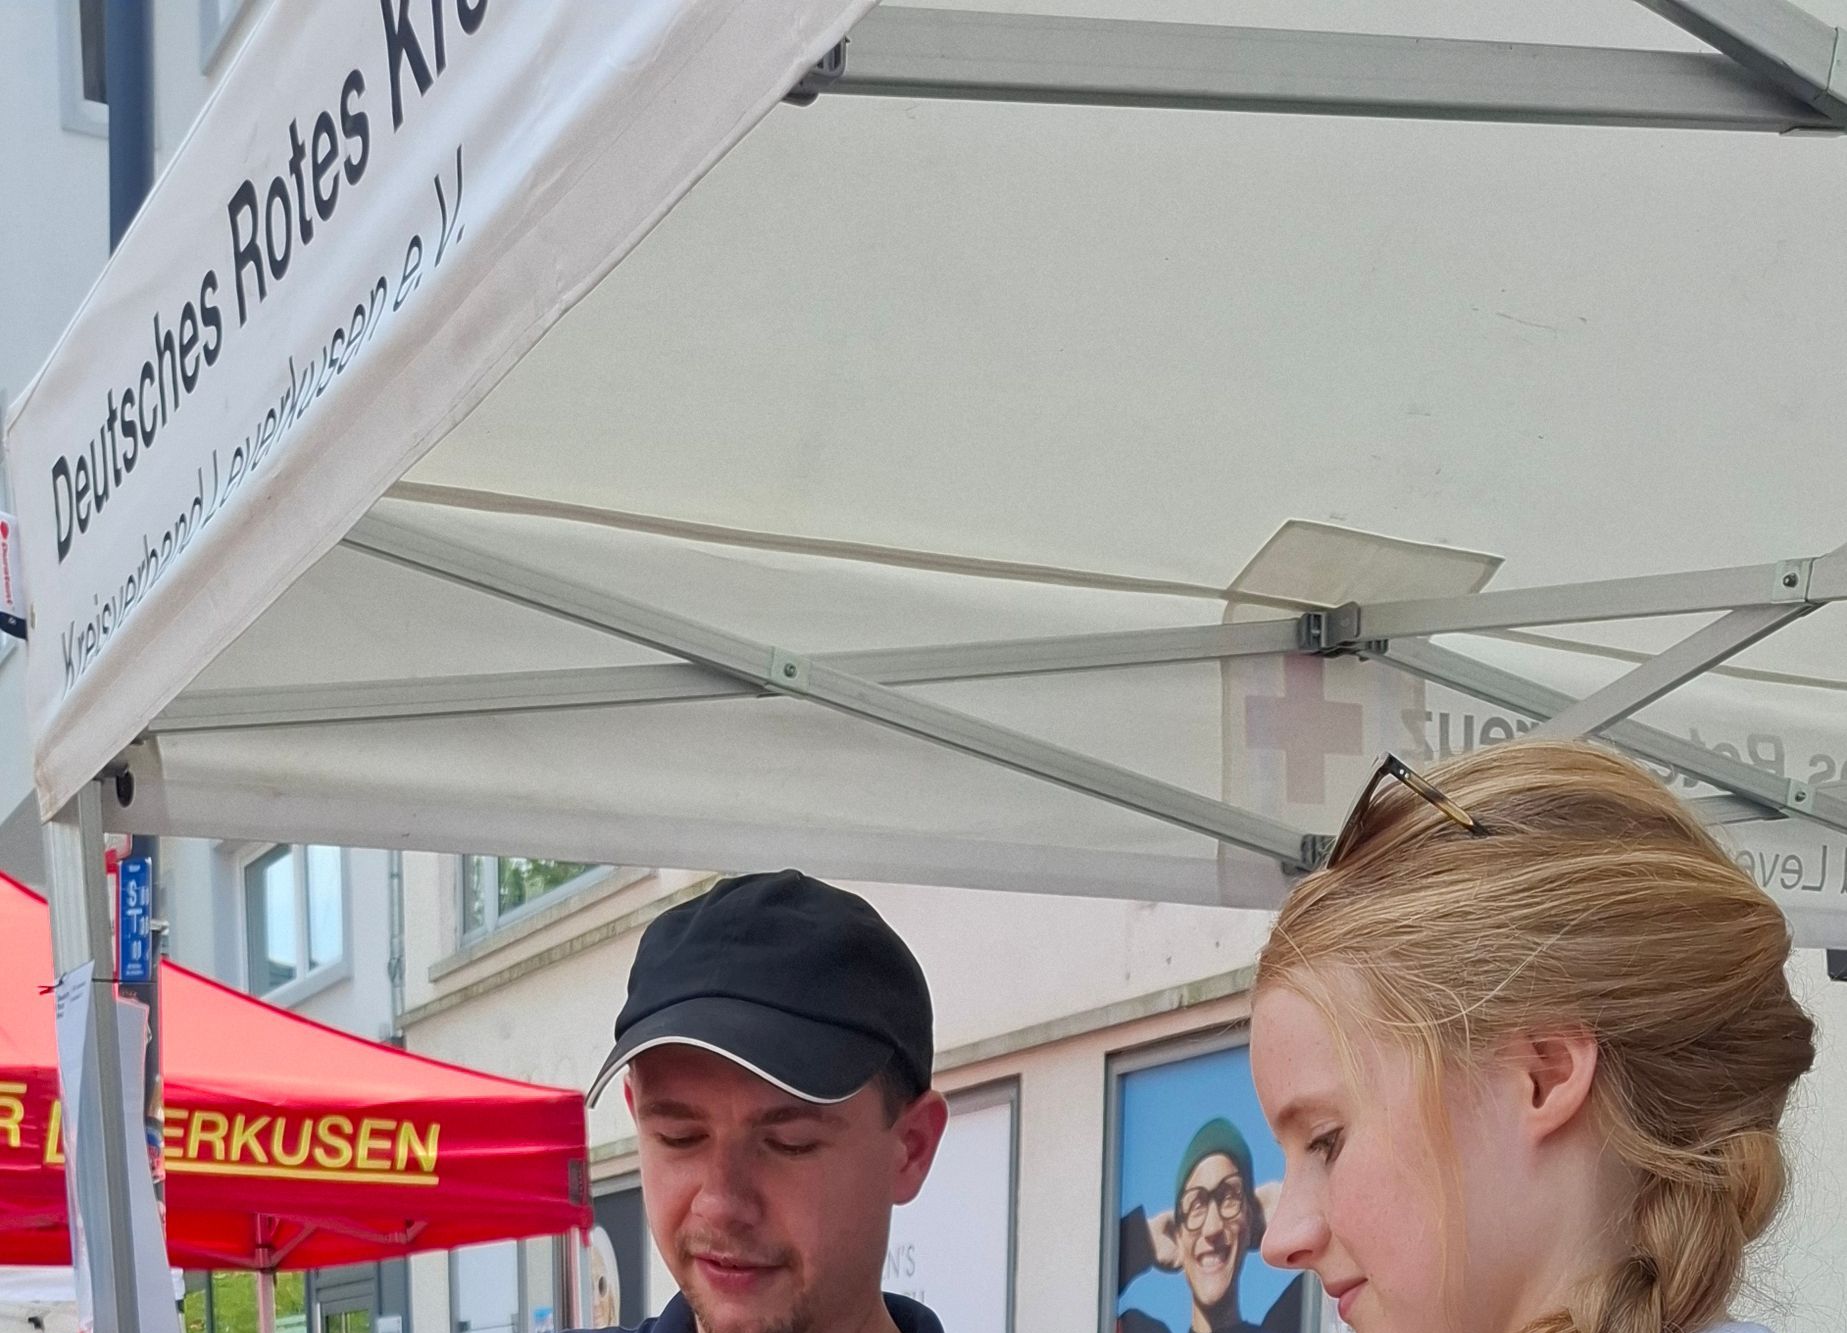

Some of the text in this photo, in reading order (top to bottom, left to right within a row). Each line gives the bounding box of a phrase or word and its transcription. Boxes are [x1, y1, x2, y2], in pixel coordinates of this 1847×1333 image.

[52, 269, 223, 564] Deutsches
[227, 68, 370, 328] Rotes
[60, 144, 466, 700] Kreisverband Leverkusen e. V.
[43, 1100, 440, 1173] LERKUSEN
[883, 1244, 916, 1280] N'S
